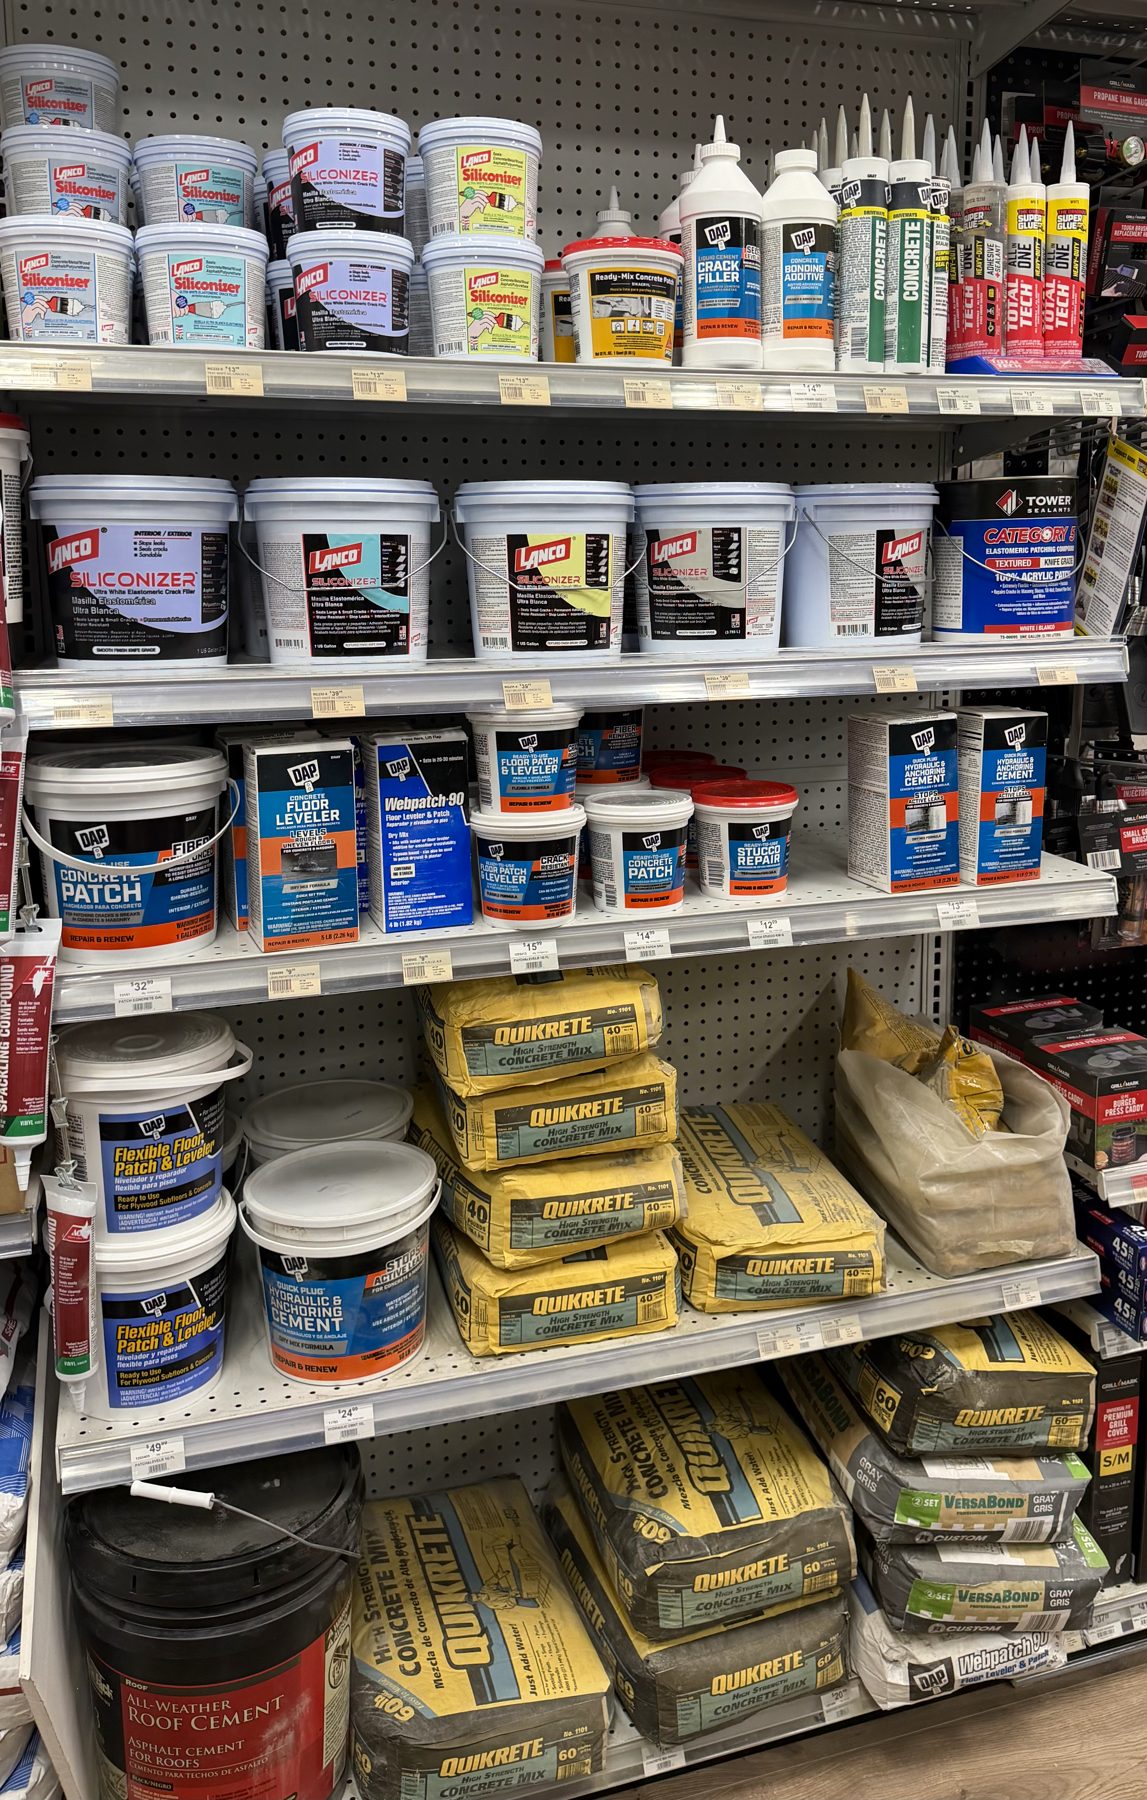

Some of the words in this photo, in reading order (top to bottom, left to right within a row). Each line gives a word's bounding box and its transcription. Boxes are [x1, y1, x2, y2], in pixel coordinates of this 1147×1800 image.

[27, 97, 88, 113] Siliconizer
[1094, 92, 1118, 102] PROPANE
[1119, 96, 1132, 104] TANK
[462, 153, 489, 168] LANCO
[54, 168, 83, 180] LANCO
[180, 172, 207, 185] LANCO
[300, 170, 379, 183] SILICONIZER
[462, 169, 522, 186] Siliconizer
[55, 181, 116, 201] Siliconizer
[182, 185, 241, 203] Siliconizer
[844, 186, 859, 201] DAP
[1017, 215, 1042, 224] SUPER
[1017, 222, 1039, 230] GLUE
[1056, 215, 1081, 223] SUPER
[1056, 222, 1079, 230] GLUE
[708, 223, 729, 240] DAP
[794, 230, 814, 246] DAP
[873, 220, 886, 300] CONCRETE
[903, 222, 921, 300] CONCRETE
[1017, 243, 1031, 269] ONE
[1056, 243, 1070, 269] ONE
[20, 256, 46, 272] LANCO
[172, 262, 200, 277] LANCO
[698, 261, 740, 272] CRACK
[784, 264, 824, 274] BONDING
[21, 274, 90, 288] Siliconizer
[296, 270, 324, 293] LANCO
[469, 274, 497, 290] LANCO
[595, 272, 633, 282] Ready-Mix
[636, 272, 661, 282] Concrete
[698, 272, 740, 284] FILLER
[784, 272, 824, 281] ADDITIVE
[174, 277, 241, 293] Siliconizer
[308, 290, 388, 303] SILICONIZER
[470, 291, 528, 305] Siliconizer
[1007, 279, 1019, 332] TOTAL
[1020, 284, 1033, 327] TECH
[1056, 284, 1070, 327] TECH
[1026, 495, 1071, 506] TOWER
[983, 527, 1067, 544] CATEGORY
[655, 540, 691, 562] LANCO
[886, 537, 919, 561] LANCO
[986, 547, 1029, 555] ELASTOMERIC
[314, 550, 358, 571] LANCO
[520, 544, 566, 569] LANCO
[995, 559, 1032, 567] TEXTURED
[653, 568, 707, 576] SILICONIZER
[70, 572, 196, 588] SILICONIZER
[516, 575, 580, 584] SILICONIZER
[614, 725, 637, 734] FIBER
[1008, 727, 1024, 742] DAP
[521, 737, 536, 748] DAP
[915, 731, 933, 747] DAP
[501, 758, 529, 766] FLOOR
[531, 757, 558, 765] PATCH
[996, 764, 1034, 772] ANCHORING
[997, 757, 1027, 765] HYDRAULIC
[292, 765, 316, 783] DAP
[390, 762, 409, 775] DAP
[511, 766, 557, 774] LEVELER
[904, 768, 945, 776] ANCHORING
[996, 771, 1034, 780] CEMENT
[904, 775, 945, 786] CEMENT
[287, 799, 329, 813] FLOOR
[276, 810, 340, 825] LEVELER
[402, 812, 425, 820] Leveler
[80, 829, 106, 848] DAP
[291, 829, 326, 837] LEVELS
[755, 827, 769, 838] DAP
[645, 836, 659, 848] DAP
[737, 847, 781, 856] STUCCO
[541, 856, 569, 865] CRACK
[628, 859, 673, 867] CONCRETE
[737, 855, 781, 865] REPAIR
[499, 867, 527, 875] PATCH
[628, 866, 673, 879] PATCH
[489, 875, 526, 884] LEVELER
[62, 883, 142, 903] PATCH
[70, 935, 95, 943] REPAIR
[0, 964, 15, 1036] COMPOUND
[494, 1016, 593, 1047] QUIKRETE
[606, 1026, 621, 1035] 40
[498, 1050, 563, 1067] CONCRETE
[1113, 1097, 1136, 1108] BURGER
[529, 1097, 624, 1128] QUIKRETE
[1105, 1106, 1125, 1117] PRESS
[1126, 1103, 1144, 1115] CADDY
[143, 1119, 164, 1133] DAP
[114, 1144, 170, 1163] Flexible
[114, 1161, 157, 1177] Patch
[176, 1139, 215, 1167] Leveler
[115, 1176, 148, 1184] Nivelador
[467, 1199, 487, 1224] 40
[542, 1192, 634, 1220] QUIKRETE
[746, 1257, 835, 1277] QUIKRETE
[748, 1286, 807, 1294] CONCRETE
[532, 1286, 625, 1316] QUIKRETE
[271, 1309, 344, 1332] CEMENT
[535, 1319, 597, 1336] CONCRETE
[117, 1320, 170, 1340] Flexible
[117, 1338, 159, 1354] Patch
[178, 1312, 216, 1342] Leveler
[305, 1364, 338, 1373] RENEW
[953, 1404, 1046, 1427] QUIKRETE
[1103, 1409, 1133, 1422] PREMIUM
[1109, 1419, 1127, 1429] GRILL
[1107, 1427, 1128, 1437] COVER
[1103, 1452, 1129, 1467] S/M
[1033, 1495, 1056, 1505] GRAY
[1034, 1504, 1053, 1513] GRIS
[933, 1534, 987, 1543] CUSTOM
[694, 1554, 789, 1593] QUIKRETE
[958, 1639, 1030, 1675] Webpatch
[711, 1650, 804, 1696] QUIKRETE
[919, 1668, 945, 1689] DAP
[125, 1679, 148, 1691] ROOF
[127, 1694, 231, 1713] ALL-WEATHER
[128, 1709, 183, 1731] ROOF
[191, 1695, 284, 1731] CEMENT
[128, 1737, 182, 1757] ASPHALT
[186, 1740, 244, 1757] CEMENT
[129, 1750, 154, 1764] FOR
[156, 1754, 200, 1769] ROOFS
[440, 1738, 545, 1778] QUIKRETE
